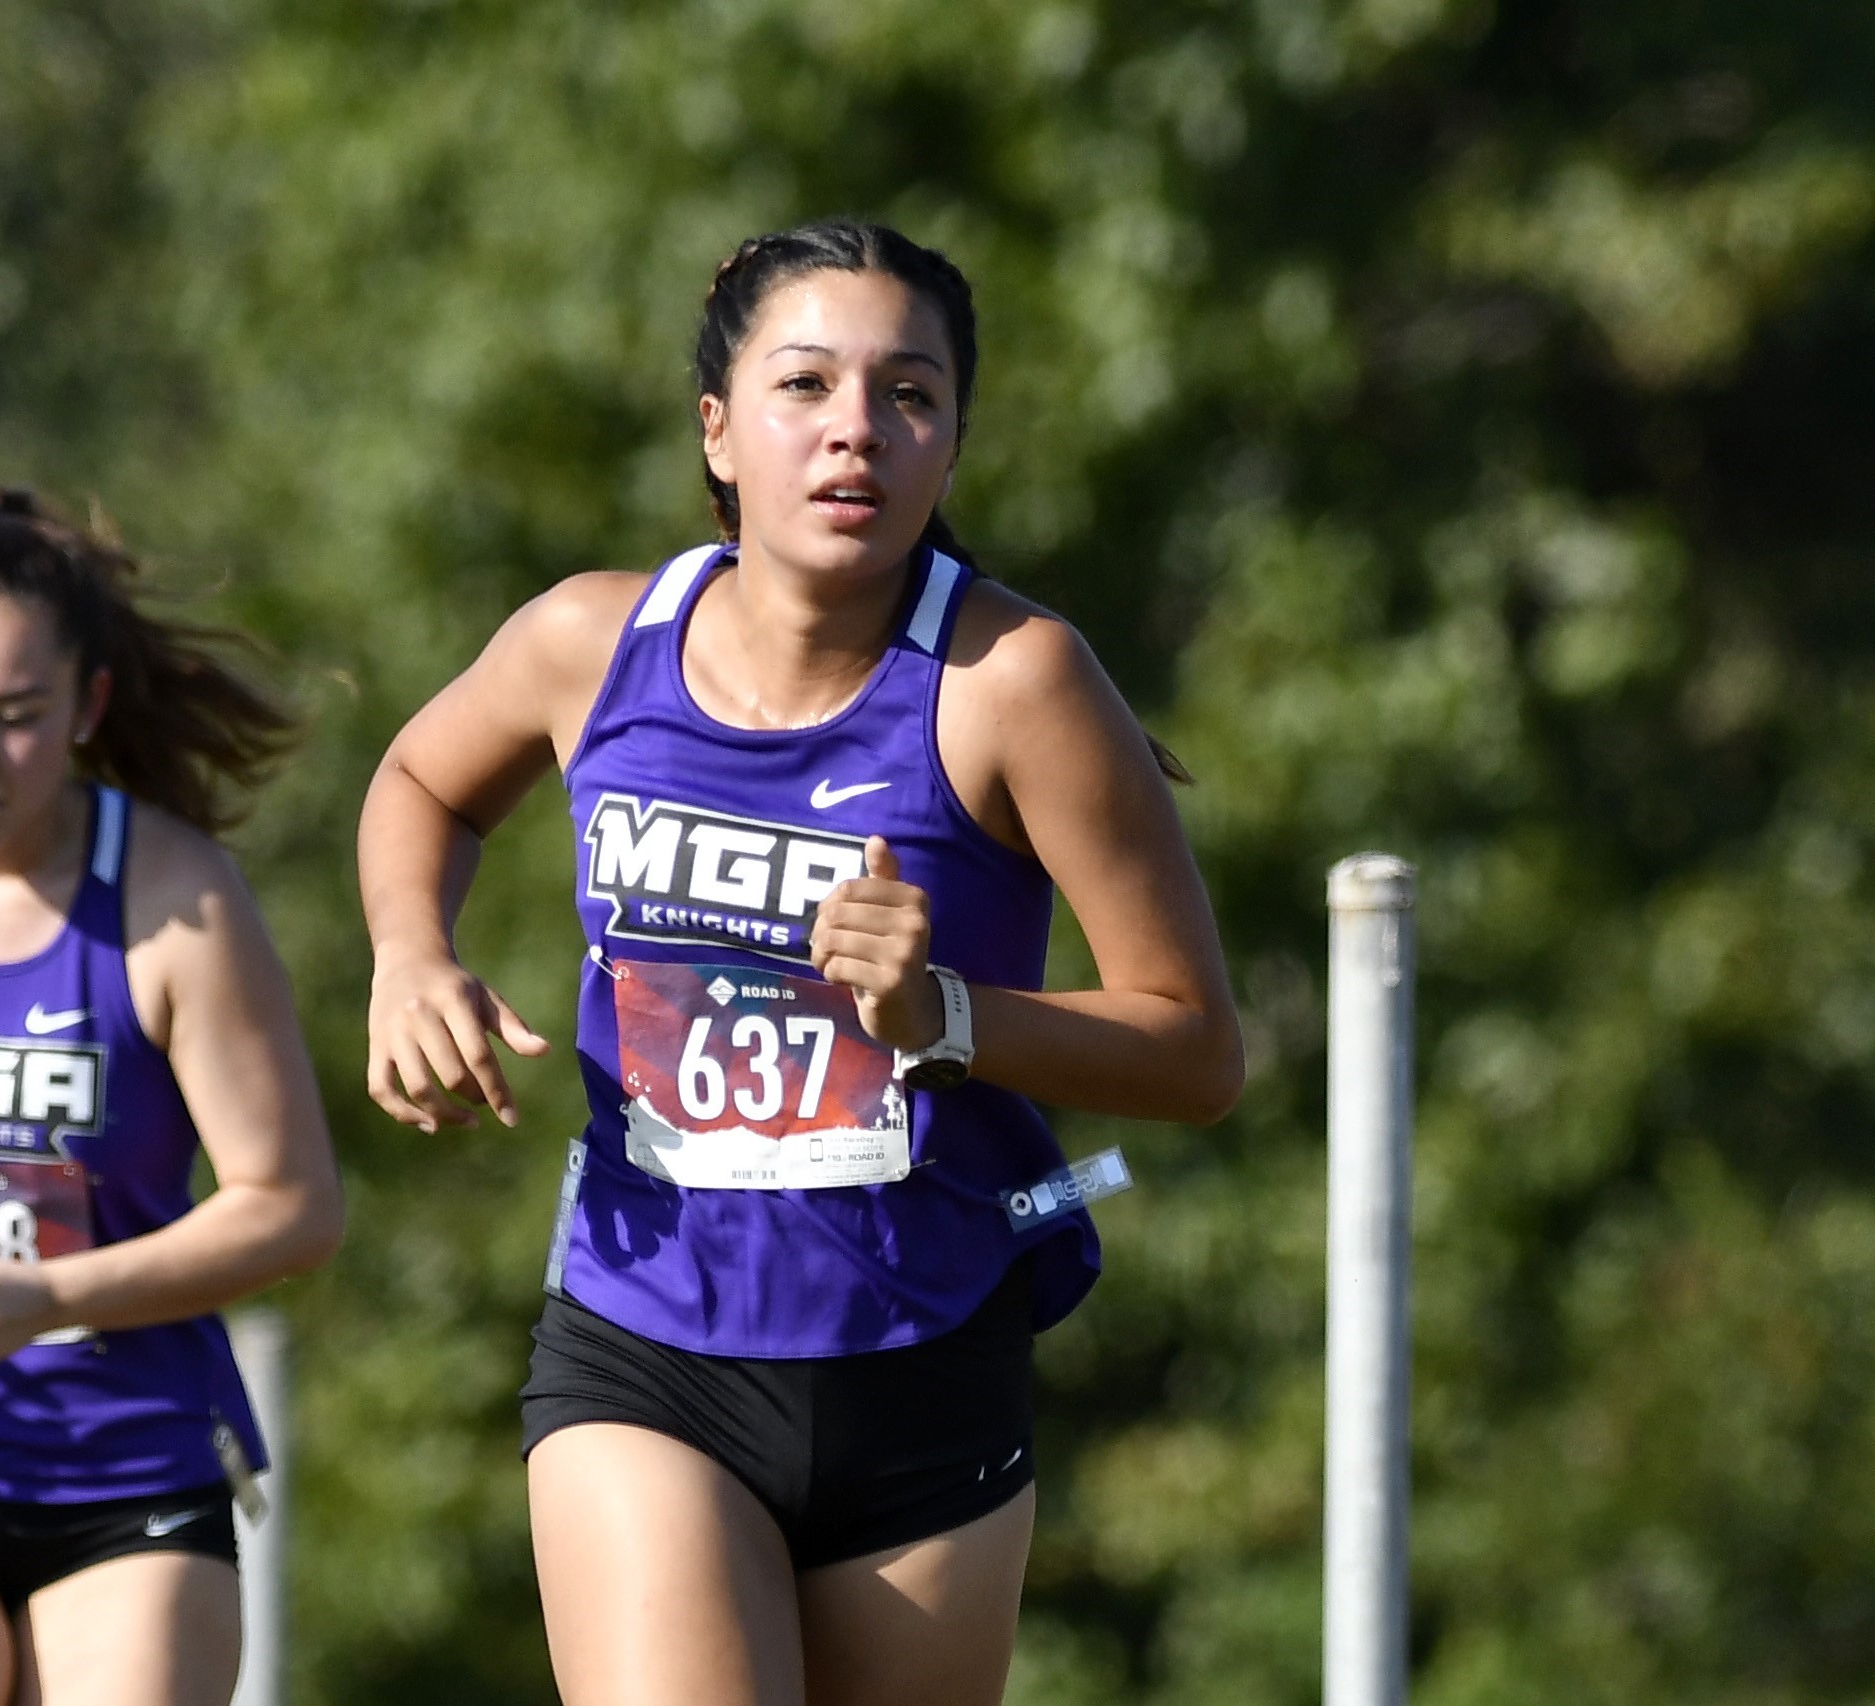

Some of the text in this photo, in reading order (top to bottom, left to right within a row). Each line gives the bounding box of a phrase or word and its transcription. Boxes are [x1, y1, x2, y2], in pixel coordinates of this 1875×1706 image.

[641, 903, 790, 946] KNIGHTS
[741, 985, 796, 1000] ROAD ID
[677, 1014, 835, 1122] 637
